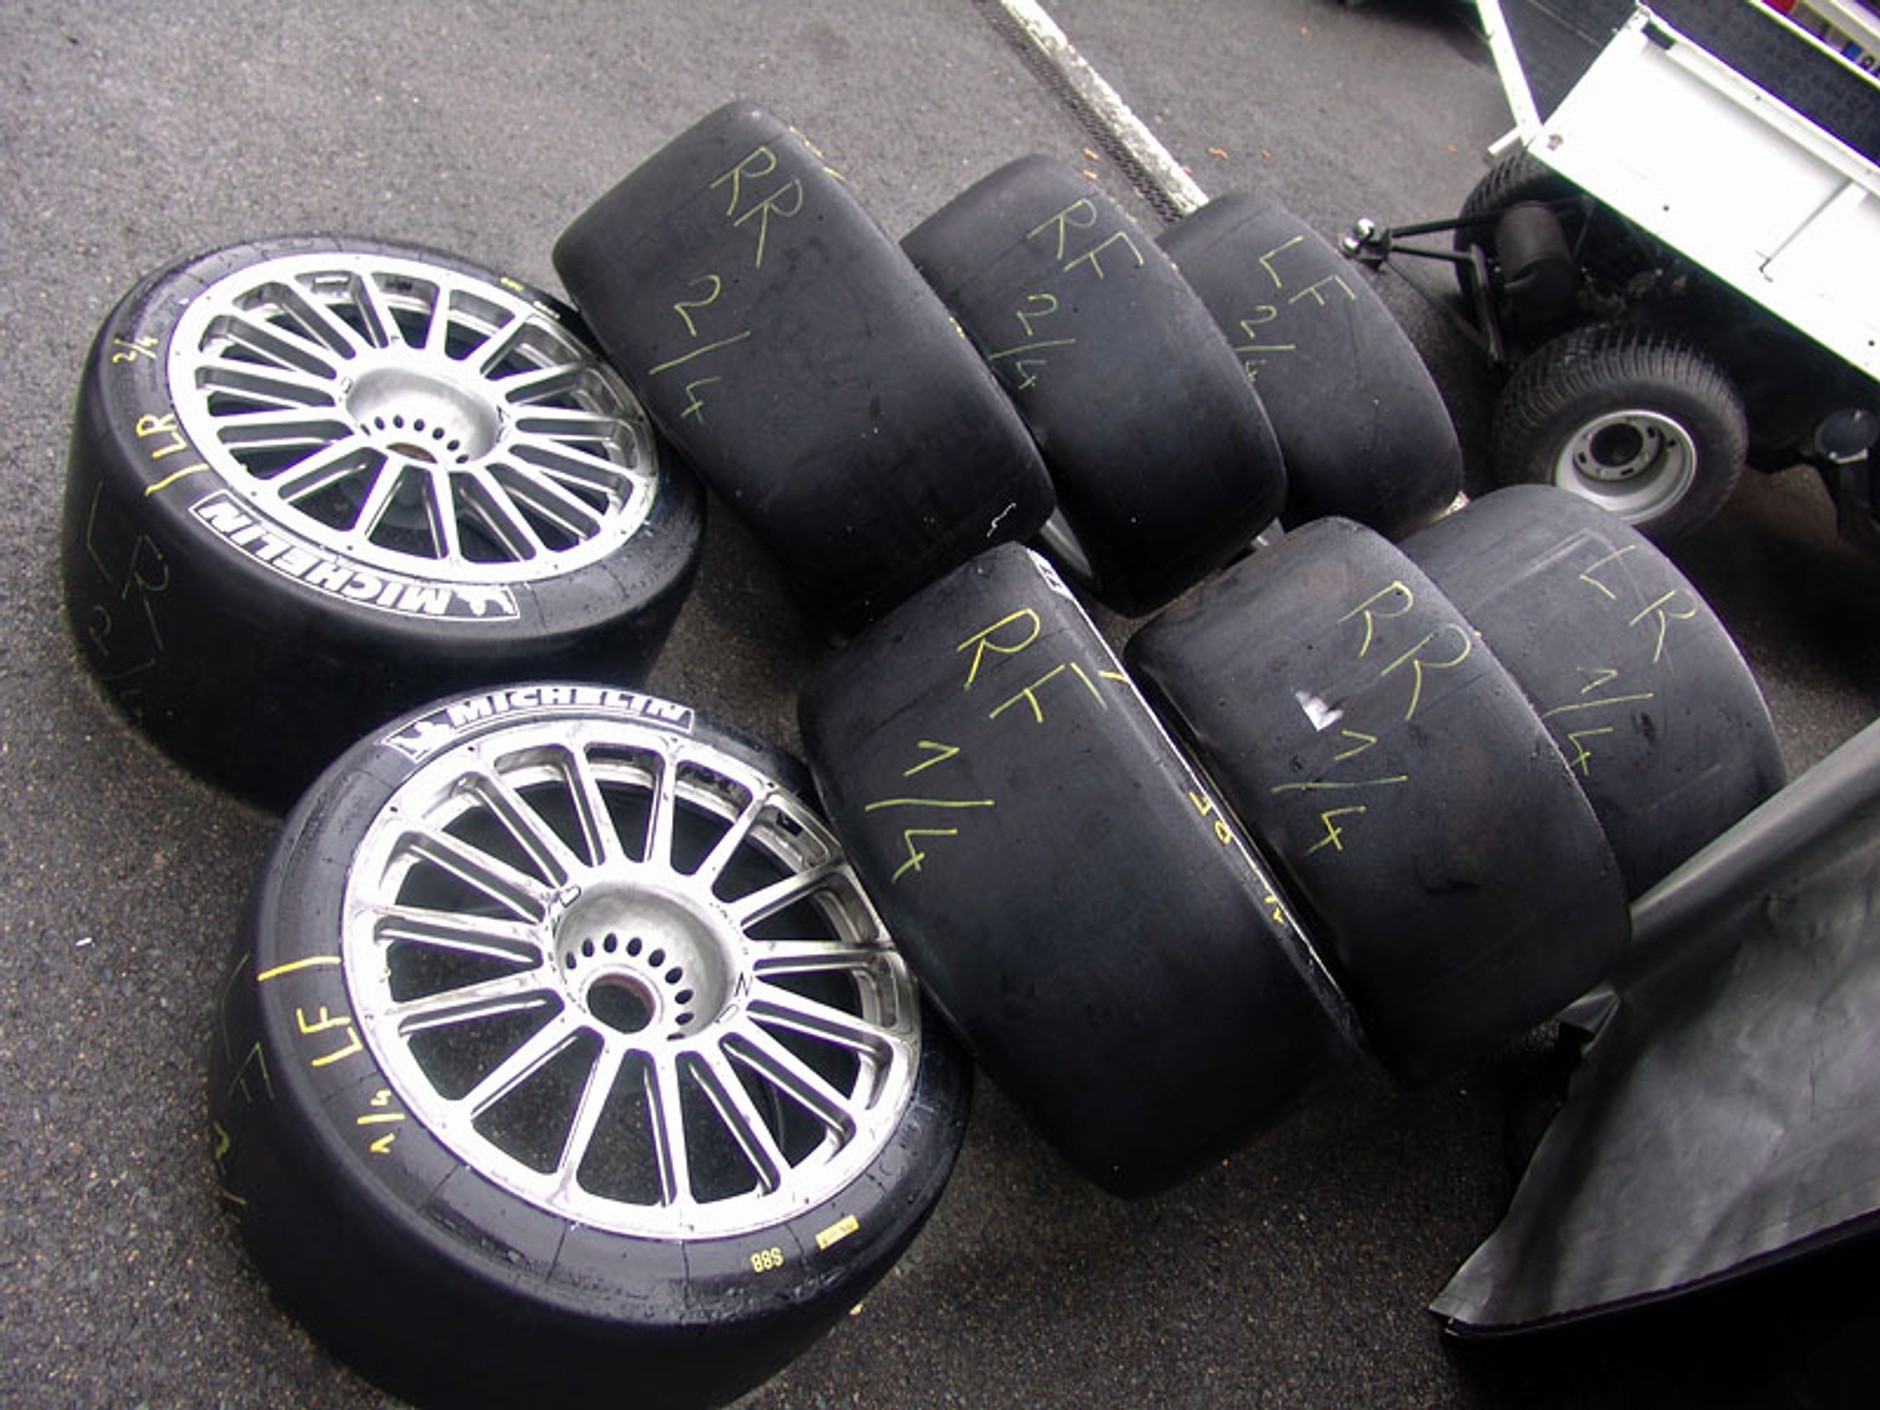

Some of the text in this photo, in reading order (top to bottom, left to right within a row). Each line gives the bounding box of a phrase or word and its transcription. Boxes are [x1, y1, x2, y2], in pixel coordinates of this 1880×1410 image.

[710, 146, 803, 269] RR
[1026, 198, 1144, 279] RF
[1258, 235, 1356, 306] LF
[648, 274, 752, 424] 2/4
[988, 293, 1076, 389] 2/4
[136, 412, 188, 459] LR
[197, 499, 453, 615] MICHELIN
[1579, 544, 1698, 663] LR
[956, 608, 1108, 723] RF
[1336, 579, 1472, 721] RR
[446, 685, 692, 730] MICHELIN
[1540, 666, 1654, 776] 1/4
[864, 740, 995, 883] 1/4
[1271, 729, 1408, 855] 1/4
[296, 1006, 363, 1067] LF
[750, 1247, 784, 1273] S88
